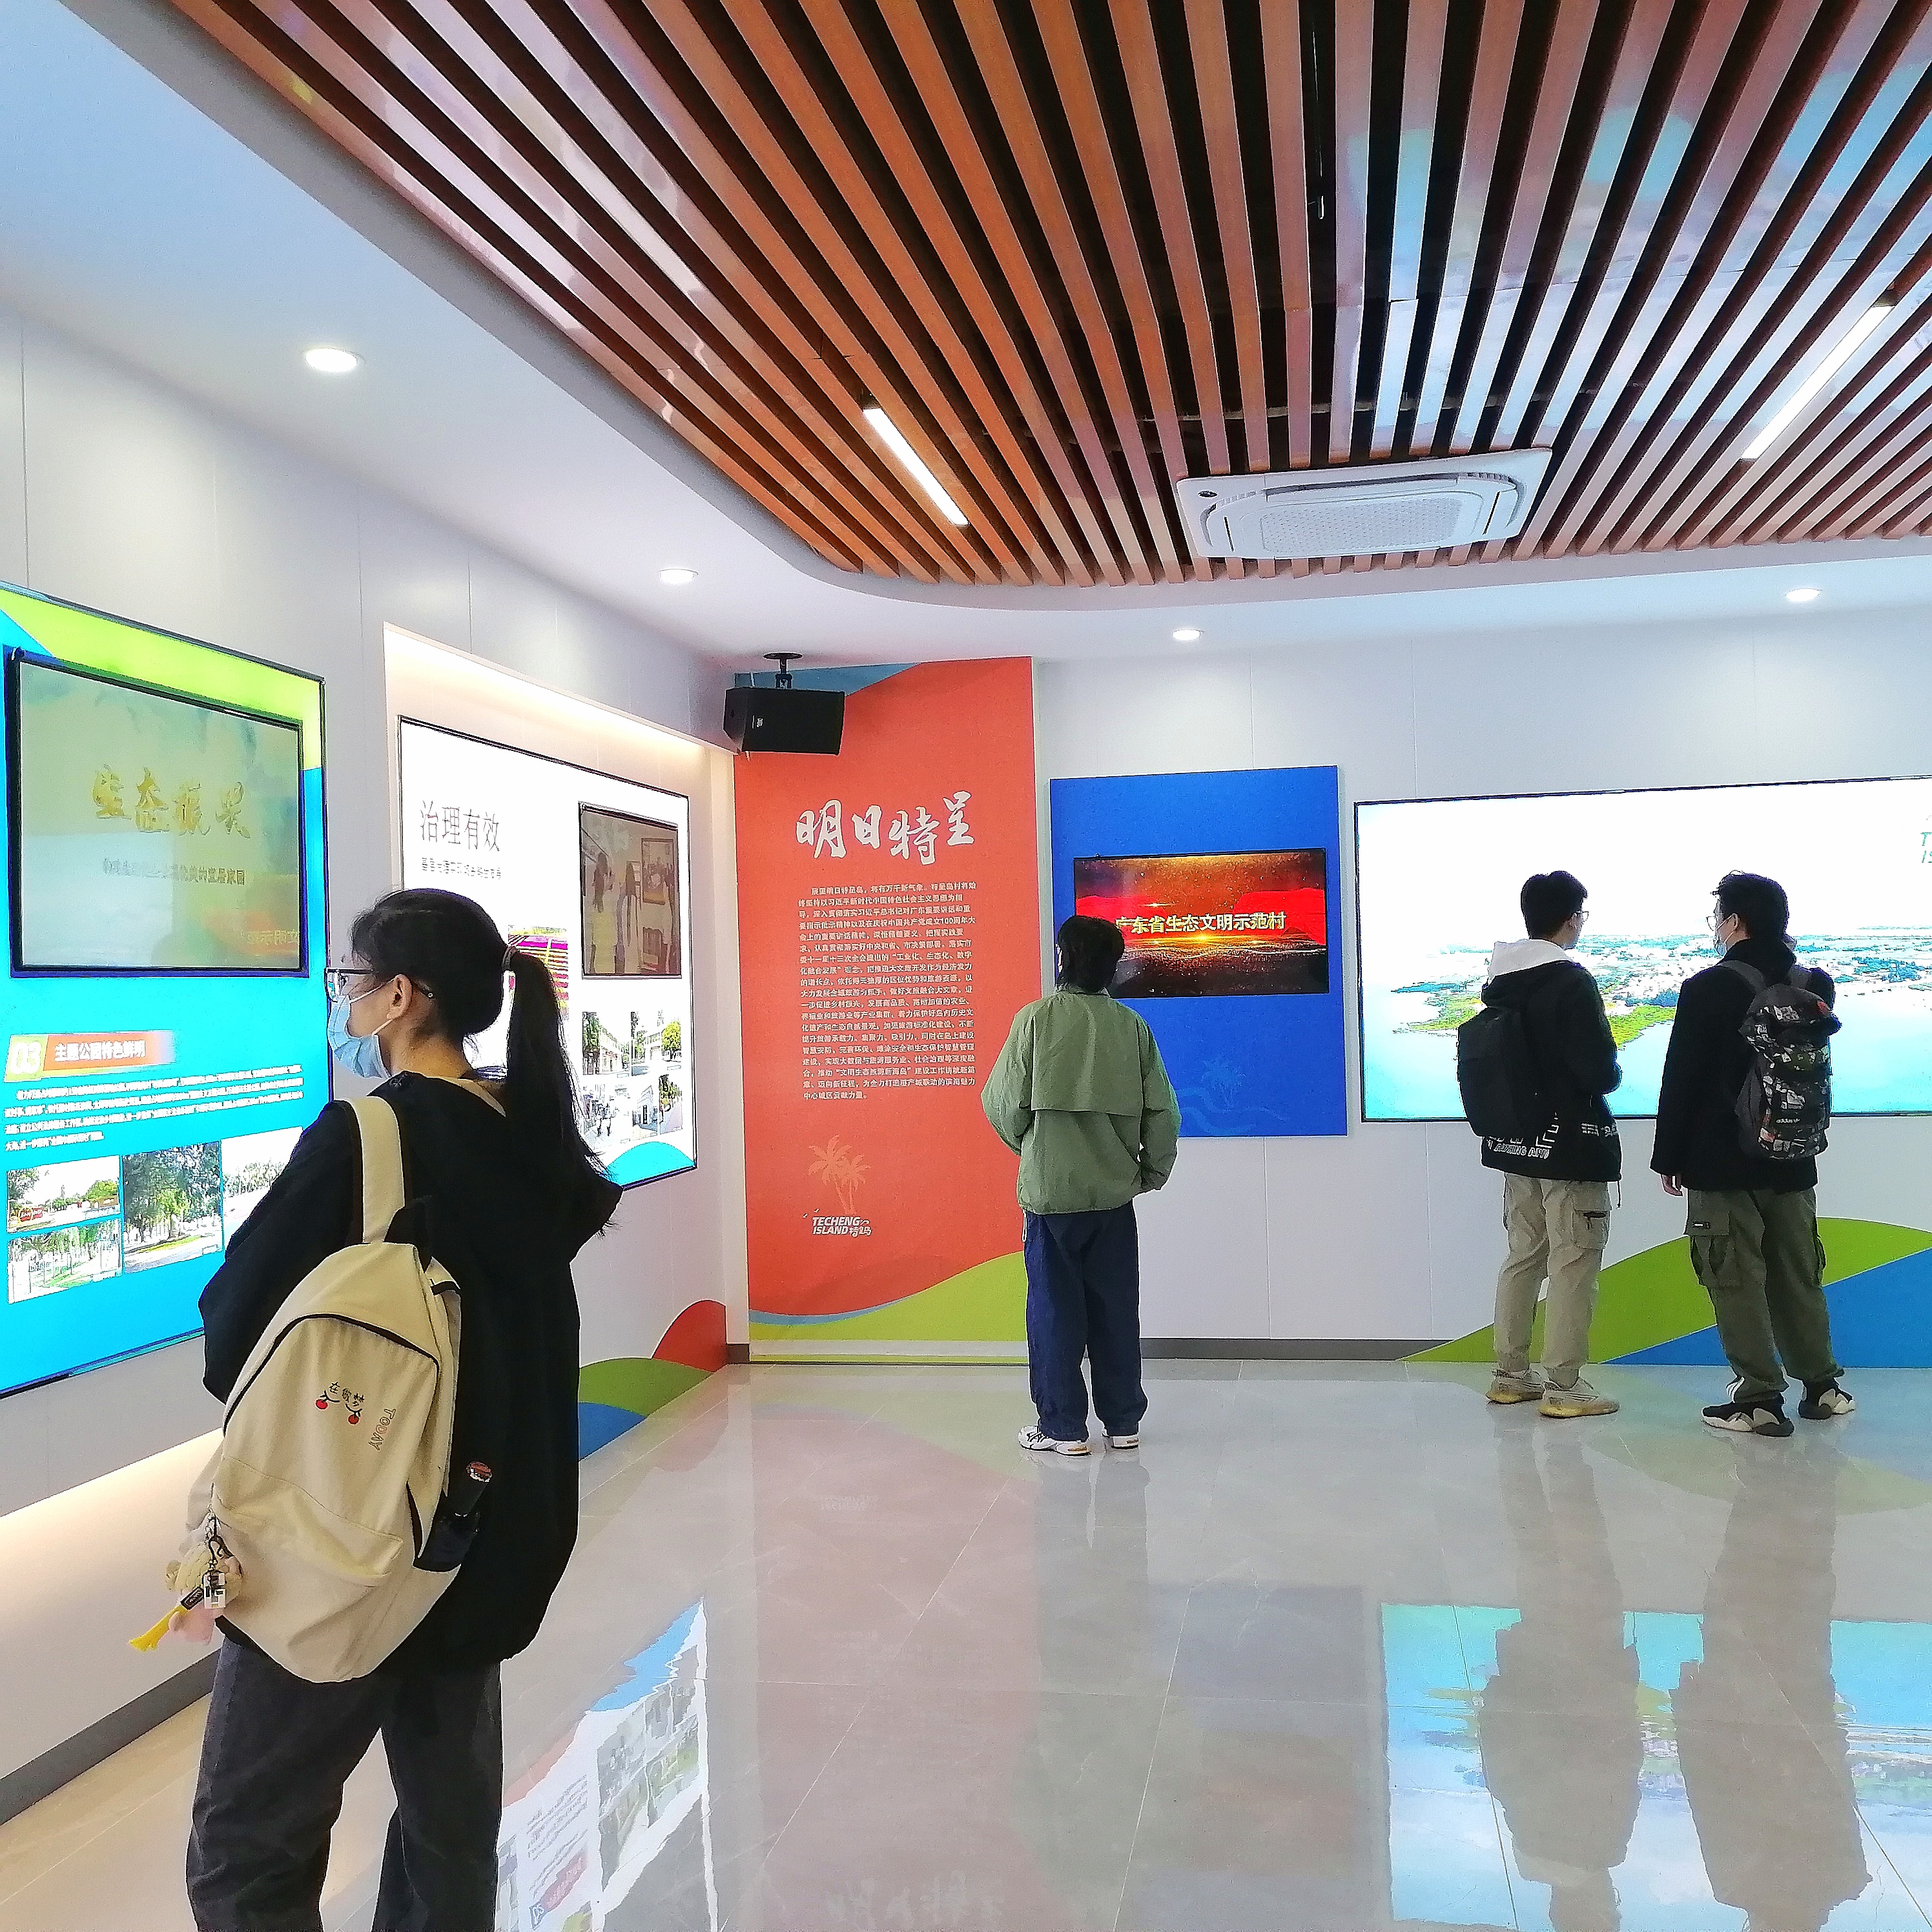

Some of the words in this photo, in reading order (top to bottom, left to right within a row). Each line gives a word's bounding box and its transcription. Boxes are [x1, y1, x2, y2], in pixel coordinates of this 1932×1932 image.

[420, 800, 500, 852] 治理有效
[796, 790, 974, 865] 明日特呈
[1115, 911, 1287, 934] 广东省生态文明示范村
[54, 1040, 146, 1062] 主题公园特色鲜明
[812, 1217, 861, 1226] TECHENG
[812, 1226, 848, 1235] ISLAND
[368, 1408, 396, 1451] TODAY
